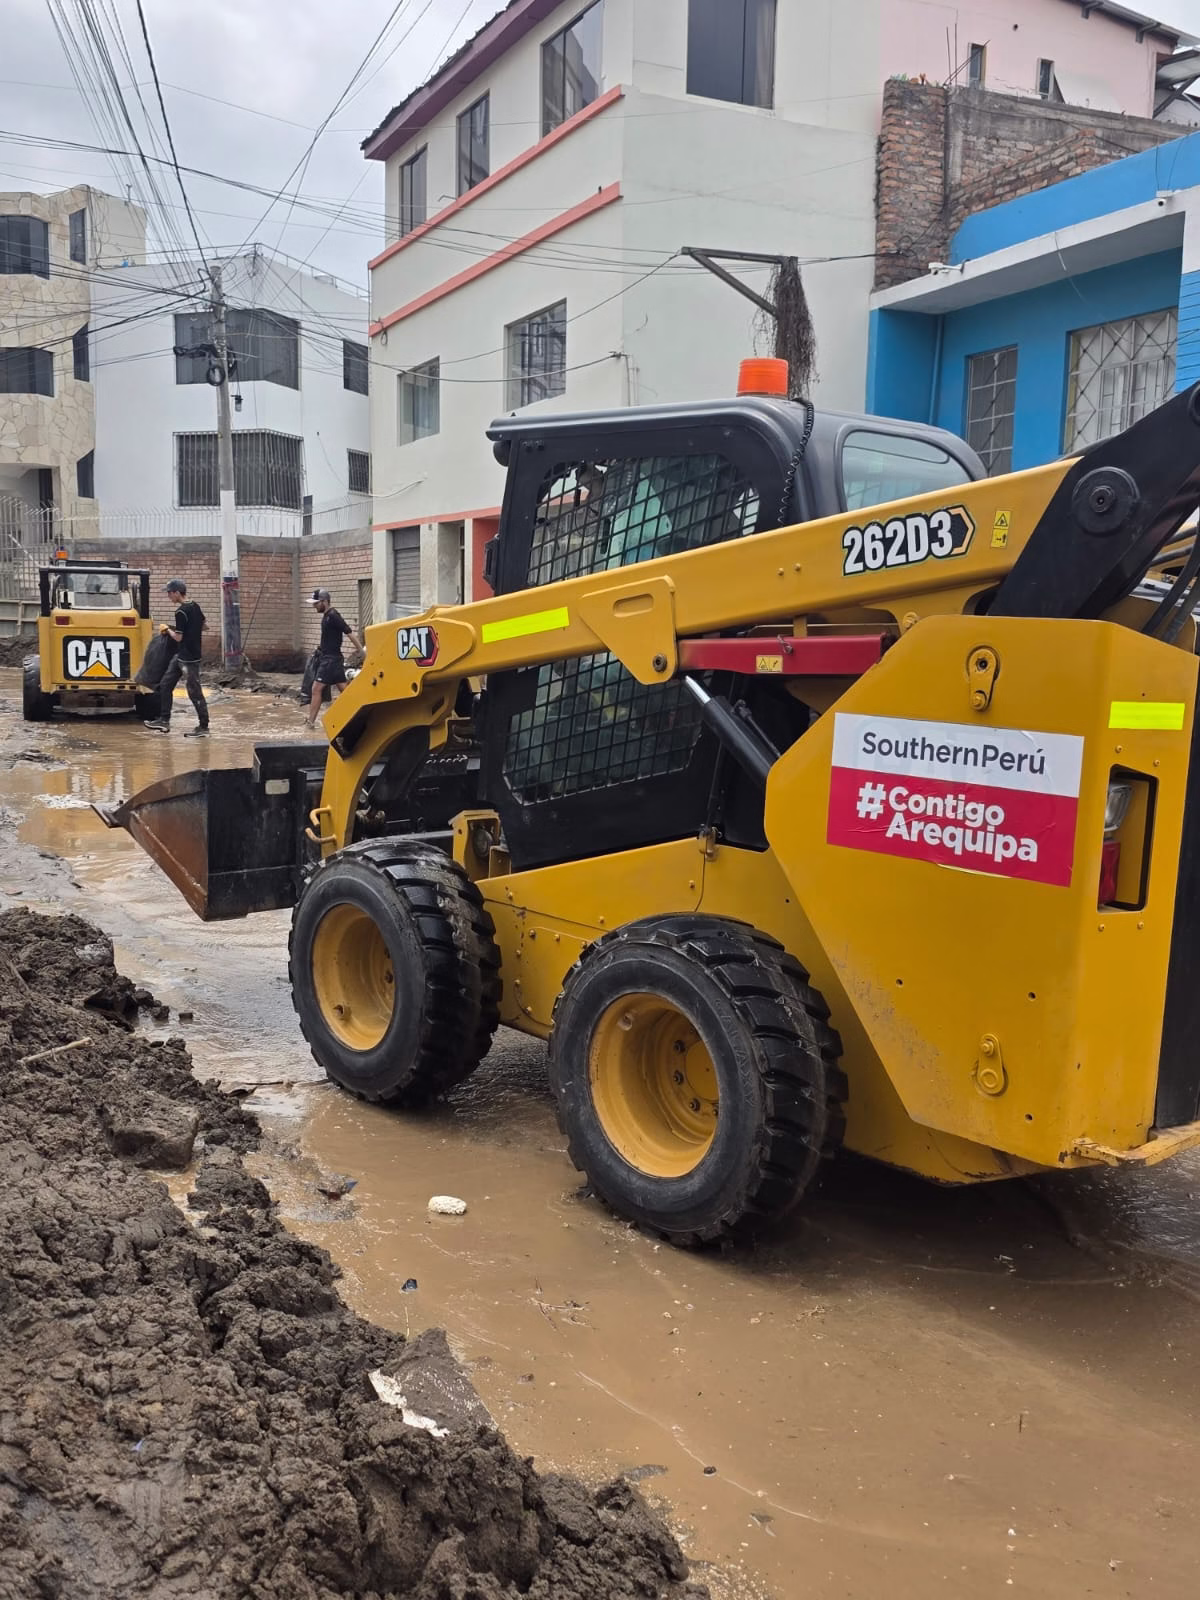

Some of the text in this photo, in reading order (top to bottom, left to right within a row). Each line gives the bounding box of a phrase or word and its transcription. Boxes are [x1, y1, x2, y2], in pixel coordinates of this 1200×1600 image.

[843, 510, 954, 574] 262D3
[67, 639, 125, 678] CAT
[398, 627, 429, 659] CAT
[856, 782, 1005, 827] #Contigo
[885, 812, 1039, 862] Arequipa
